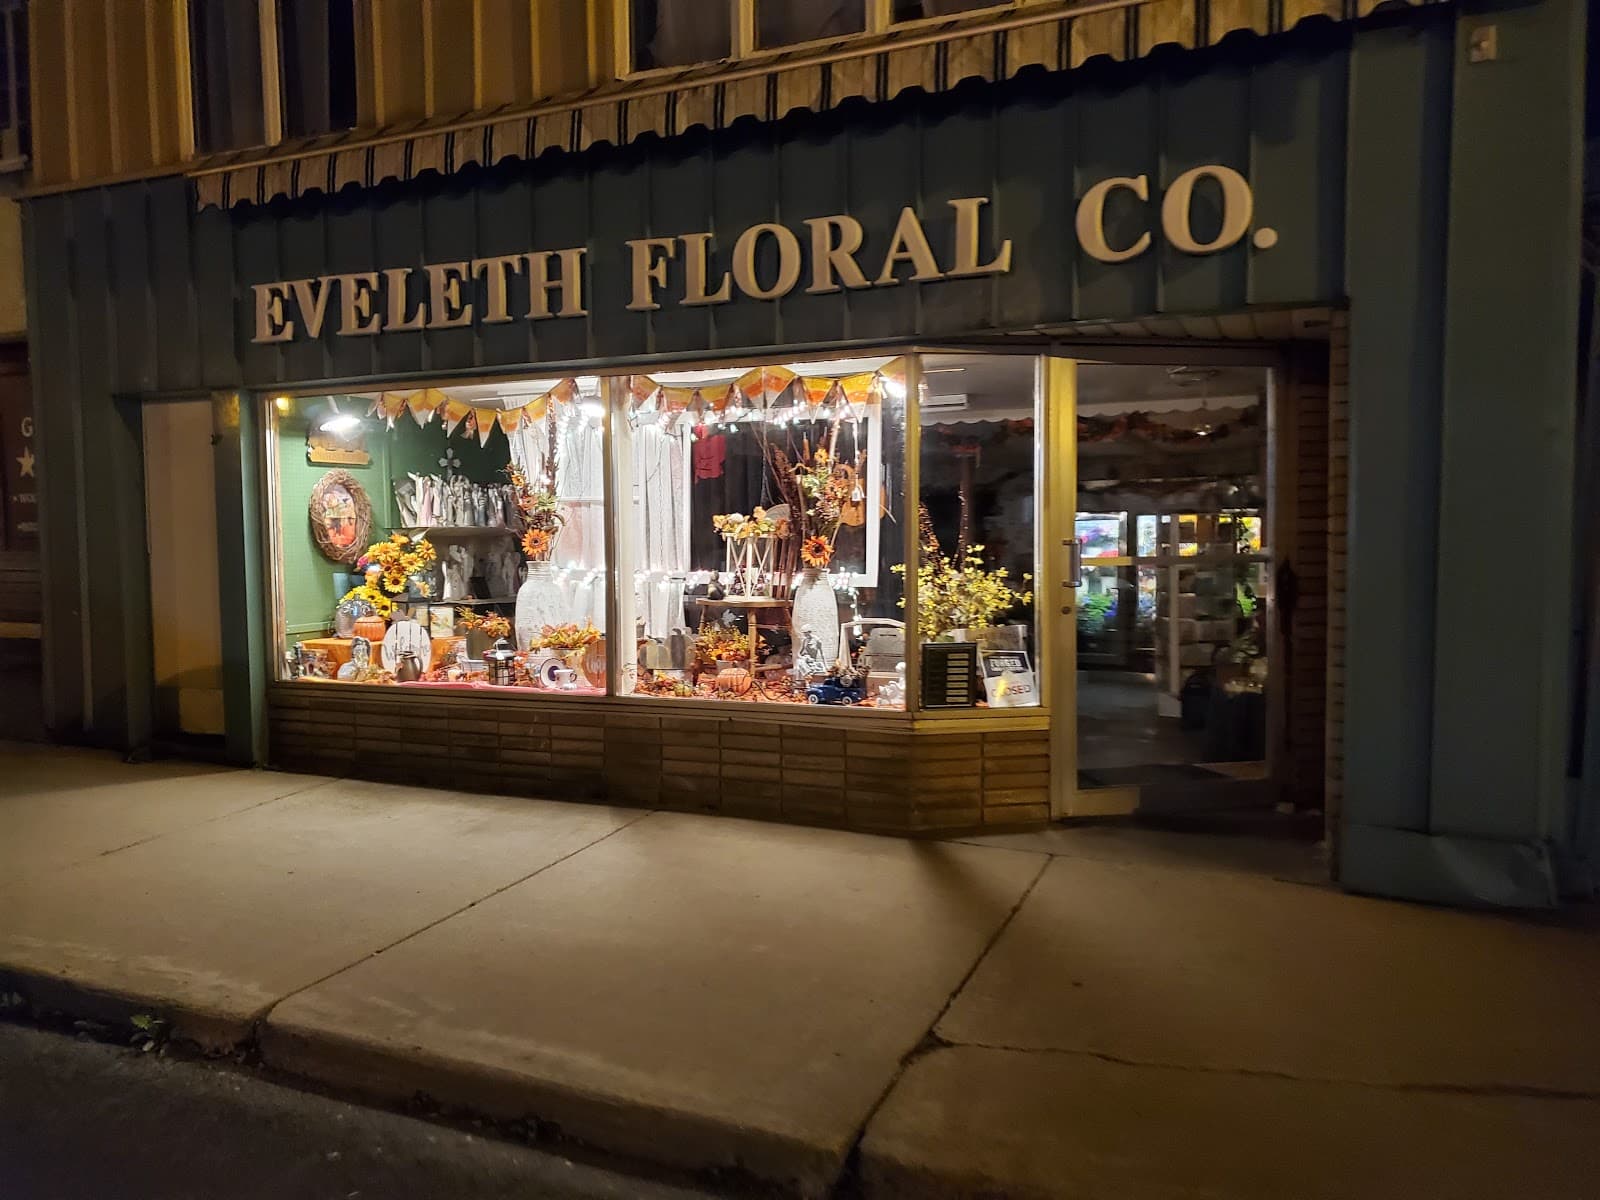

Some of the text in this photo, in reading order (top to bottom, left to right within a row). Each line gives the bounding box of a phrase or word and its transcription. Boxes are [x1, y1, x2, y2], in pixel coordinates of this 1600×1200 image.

[251, 164, 1279, 343] EVELETH FLORAL CO.
[991, 683, 1032, 698] COSED
